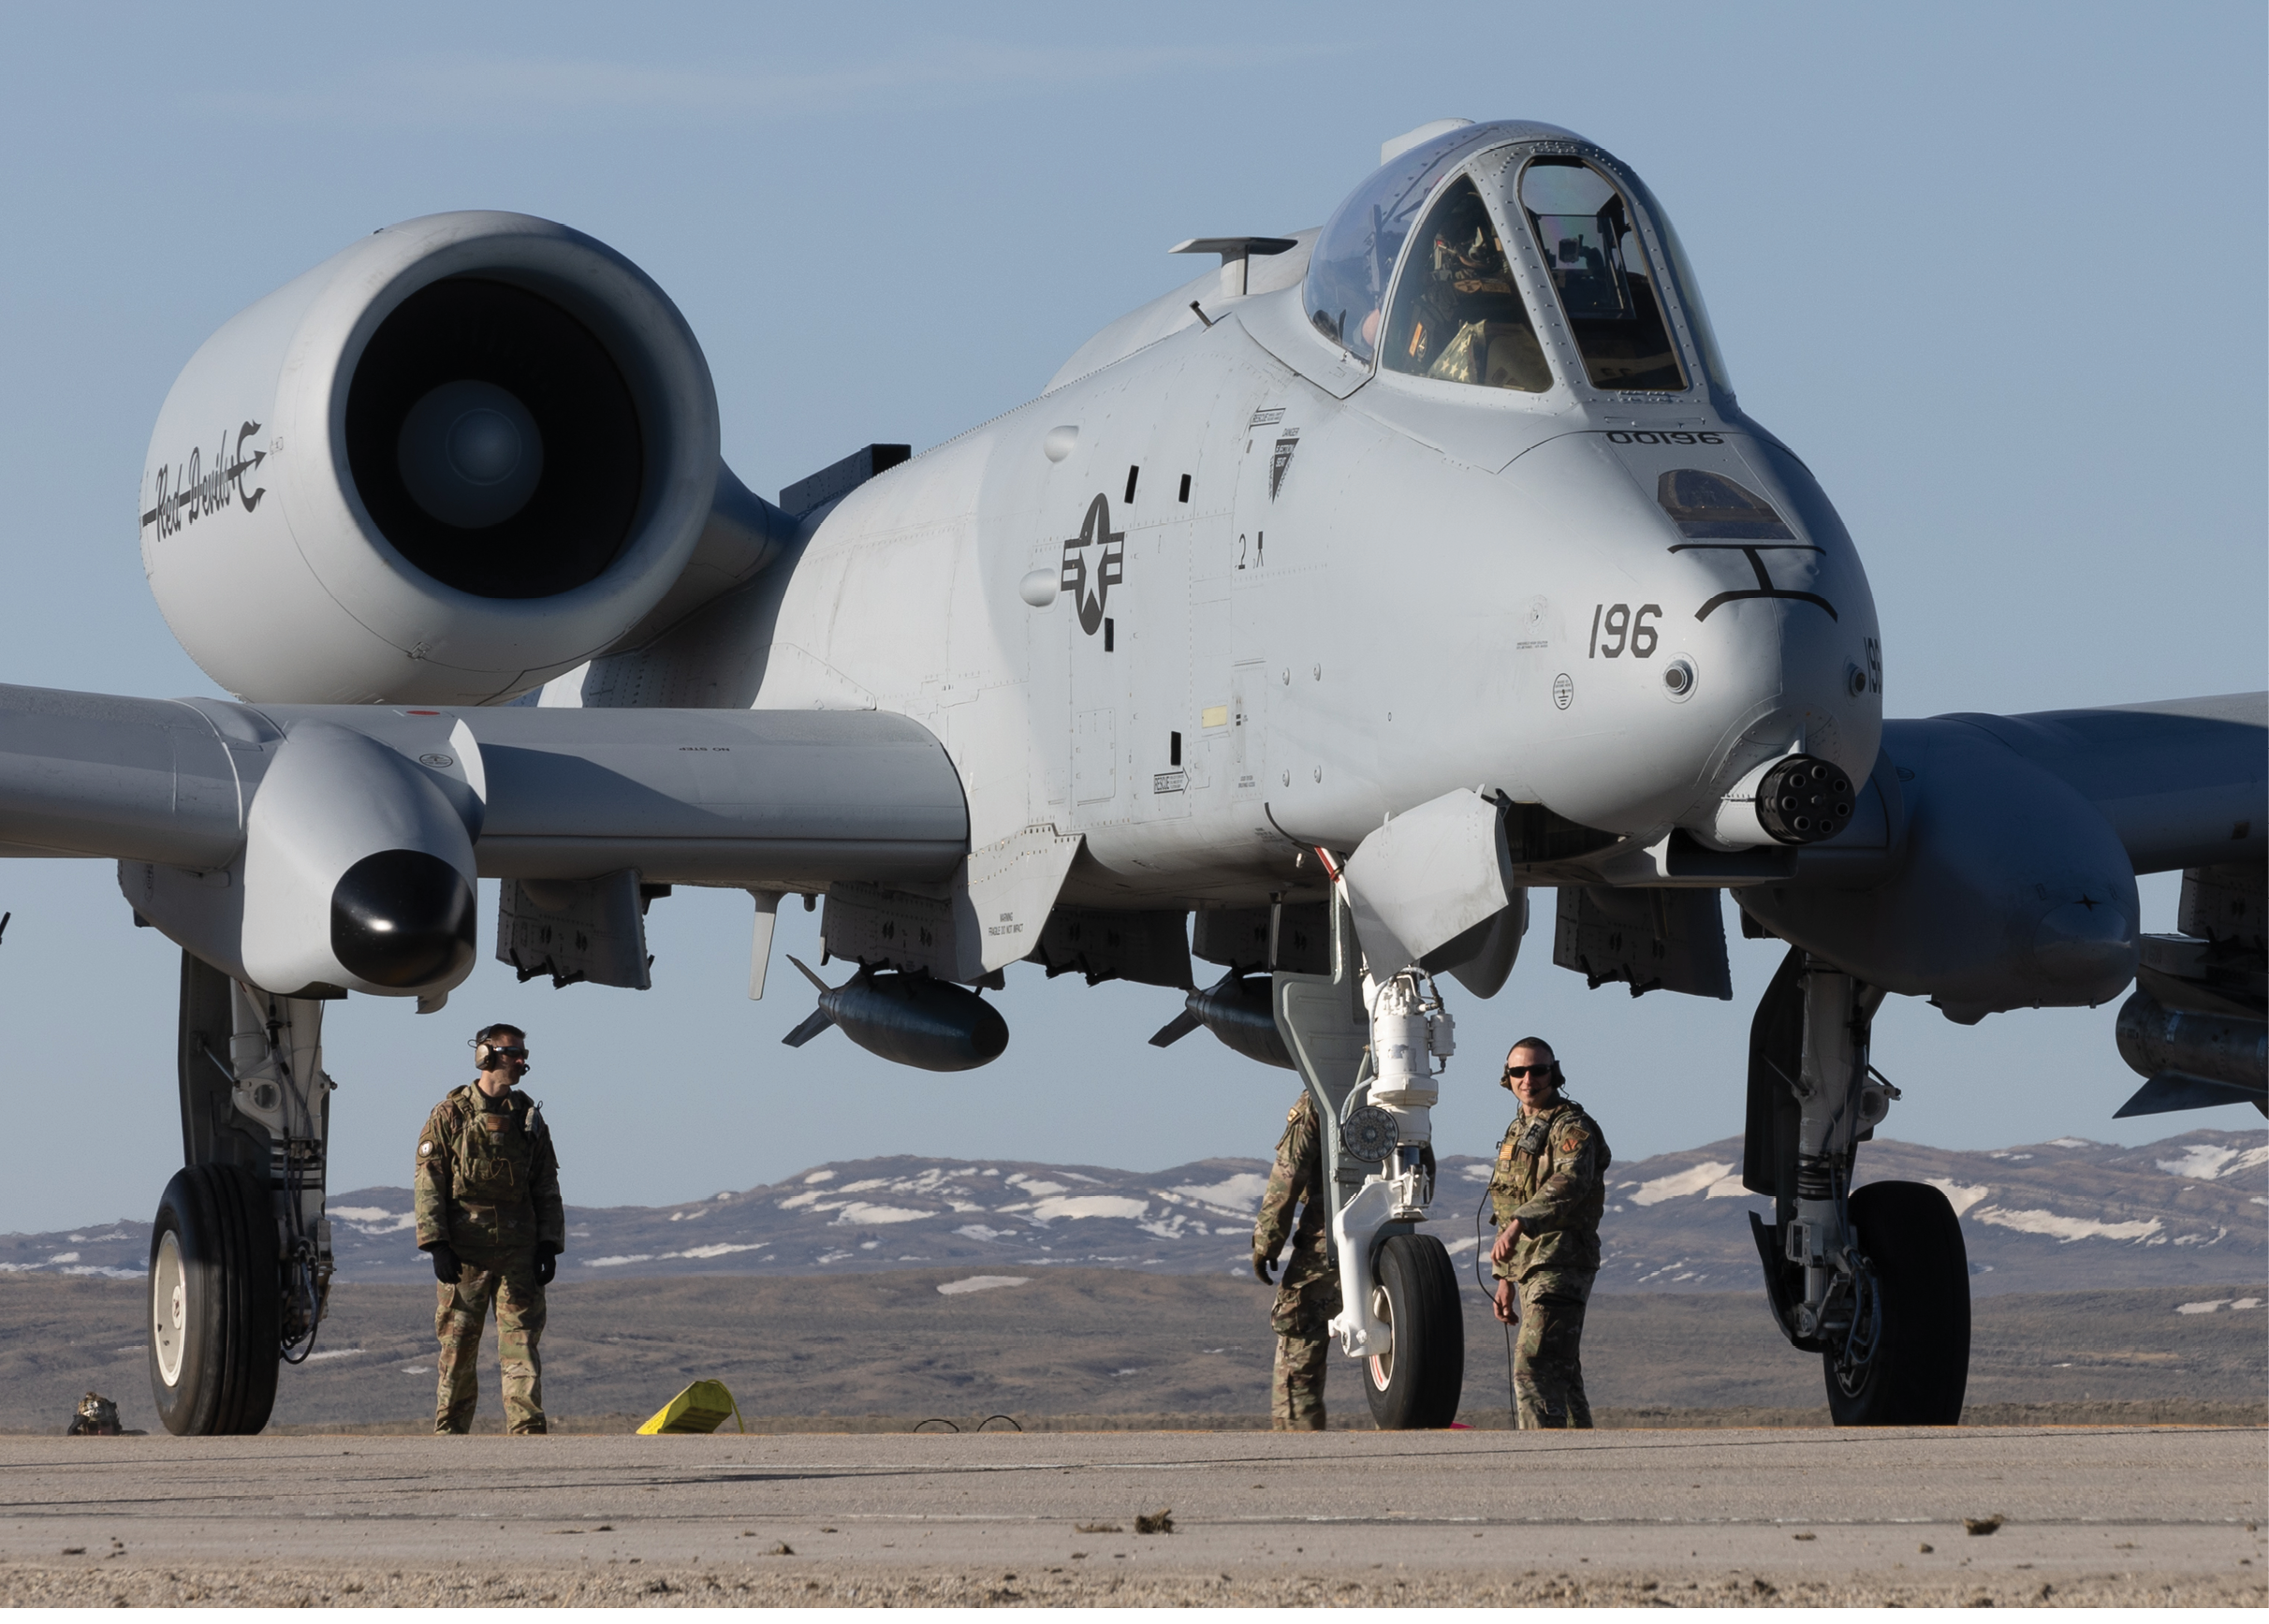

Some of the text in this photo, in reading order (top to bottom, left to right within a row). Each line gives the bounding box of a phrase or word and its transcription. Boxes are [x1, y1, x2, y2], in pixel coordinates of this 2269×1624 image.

[1281, 427, 1299, 437] DANGER
[1606, 431, 1724, 445] 00196
[155, 463, 183, 543] Red
[1588, 604, 1662, 658] 196
[1154, 776, 1170, 791] RESCUE
[1000, 912, 1013, 922] WARNING
